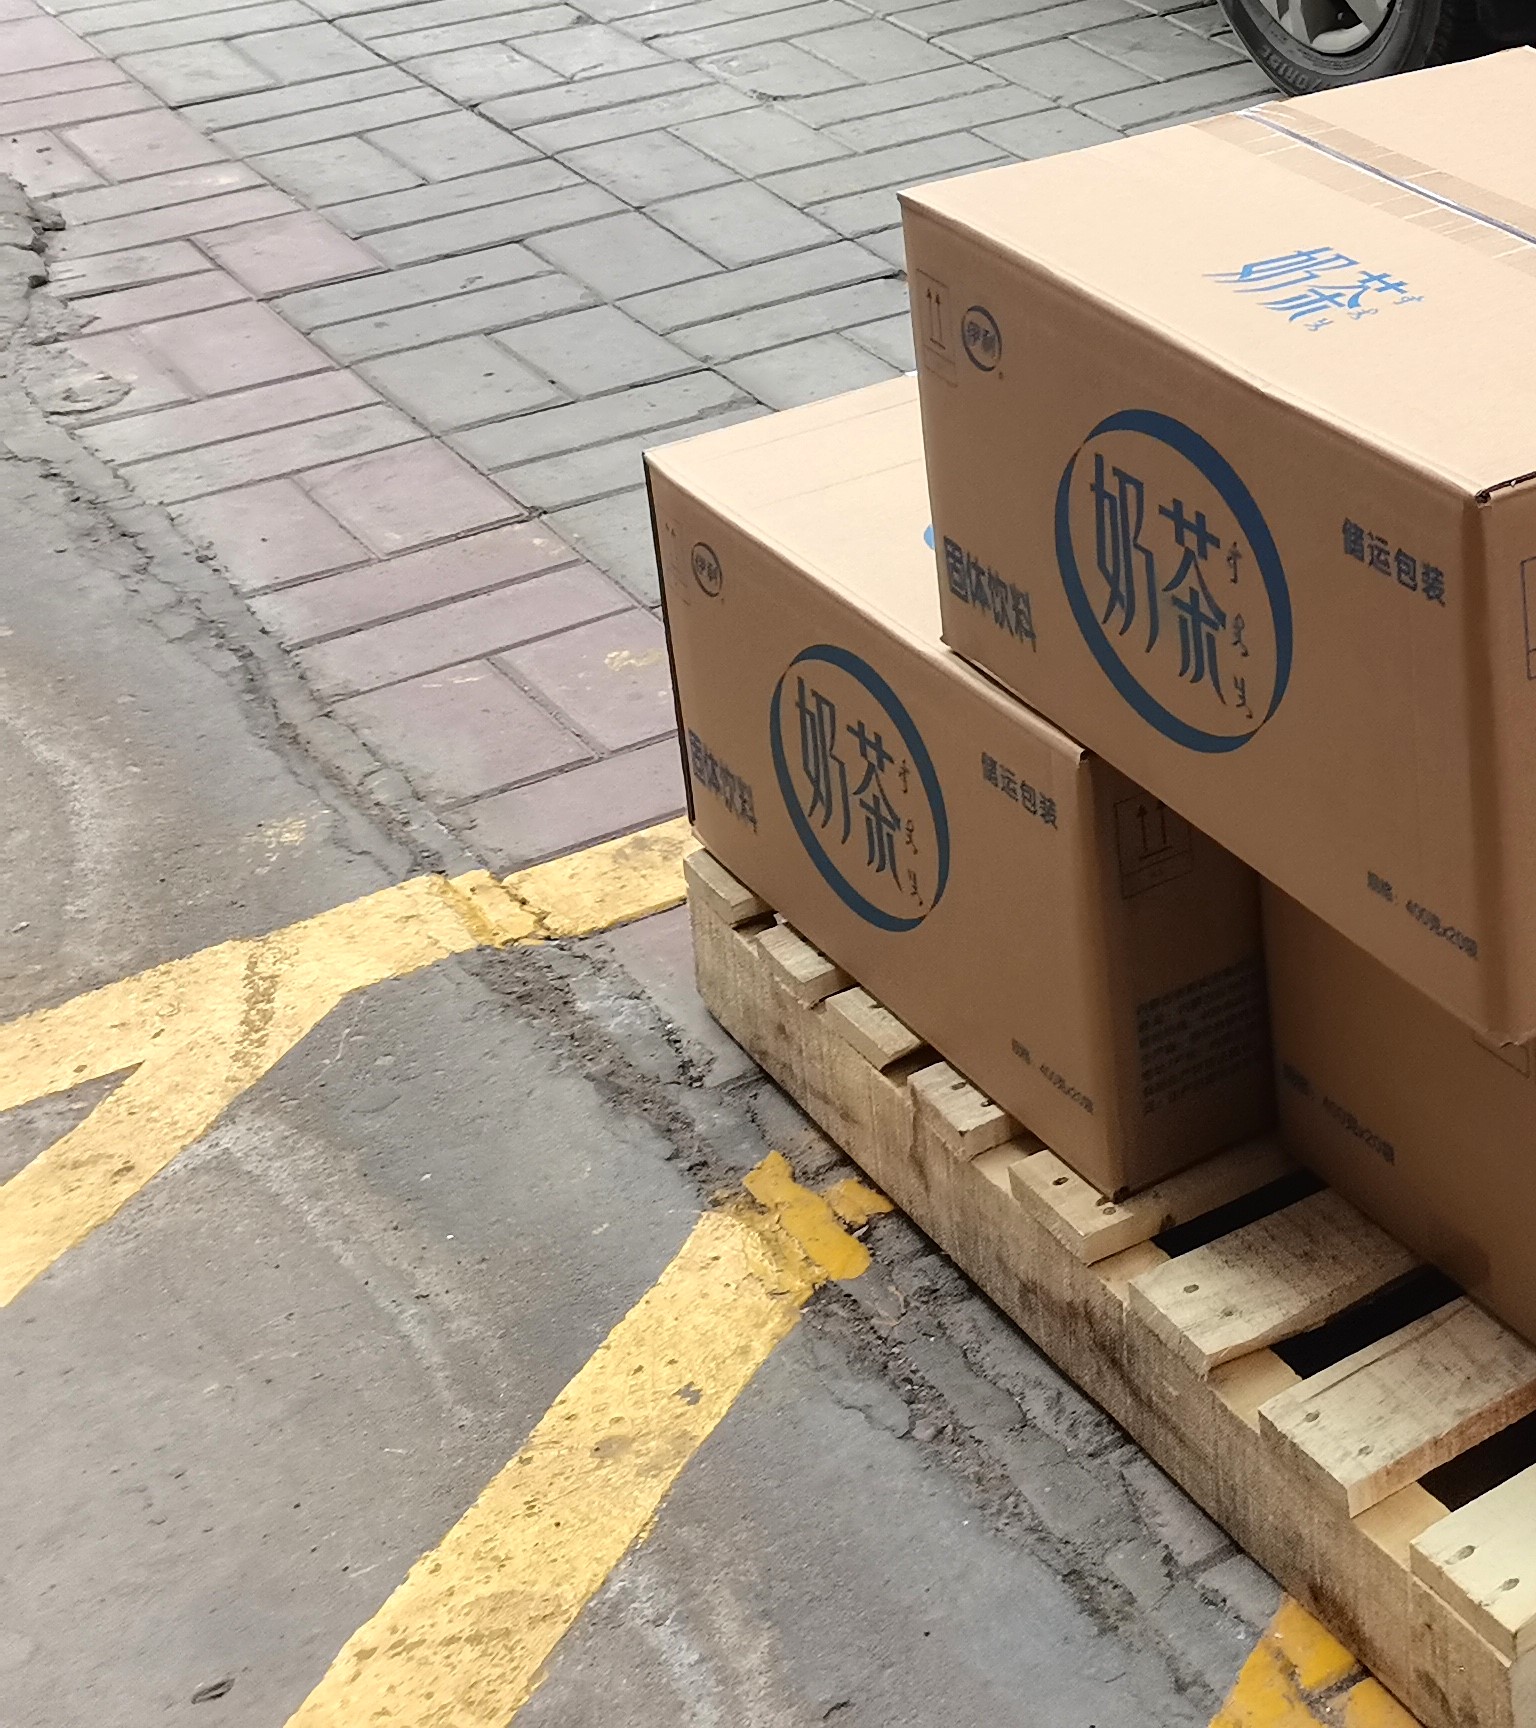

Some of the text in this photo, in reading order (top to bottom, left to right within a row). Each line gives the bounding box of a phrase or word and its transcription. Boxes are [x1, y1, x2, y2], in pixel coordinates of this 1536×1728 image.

[1202, 246, 1408, 322] 奶茶
[942, 535, 1037, 654] 固体饮料
[1089, 452, 1228, 707] 奶茶
[1341, 518, 1447, 607] 储运包装
[795, 675, 905, 896] 奶茶
[981, 751, 1058, 831] 储运包装
